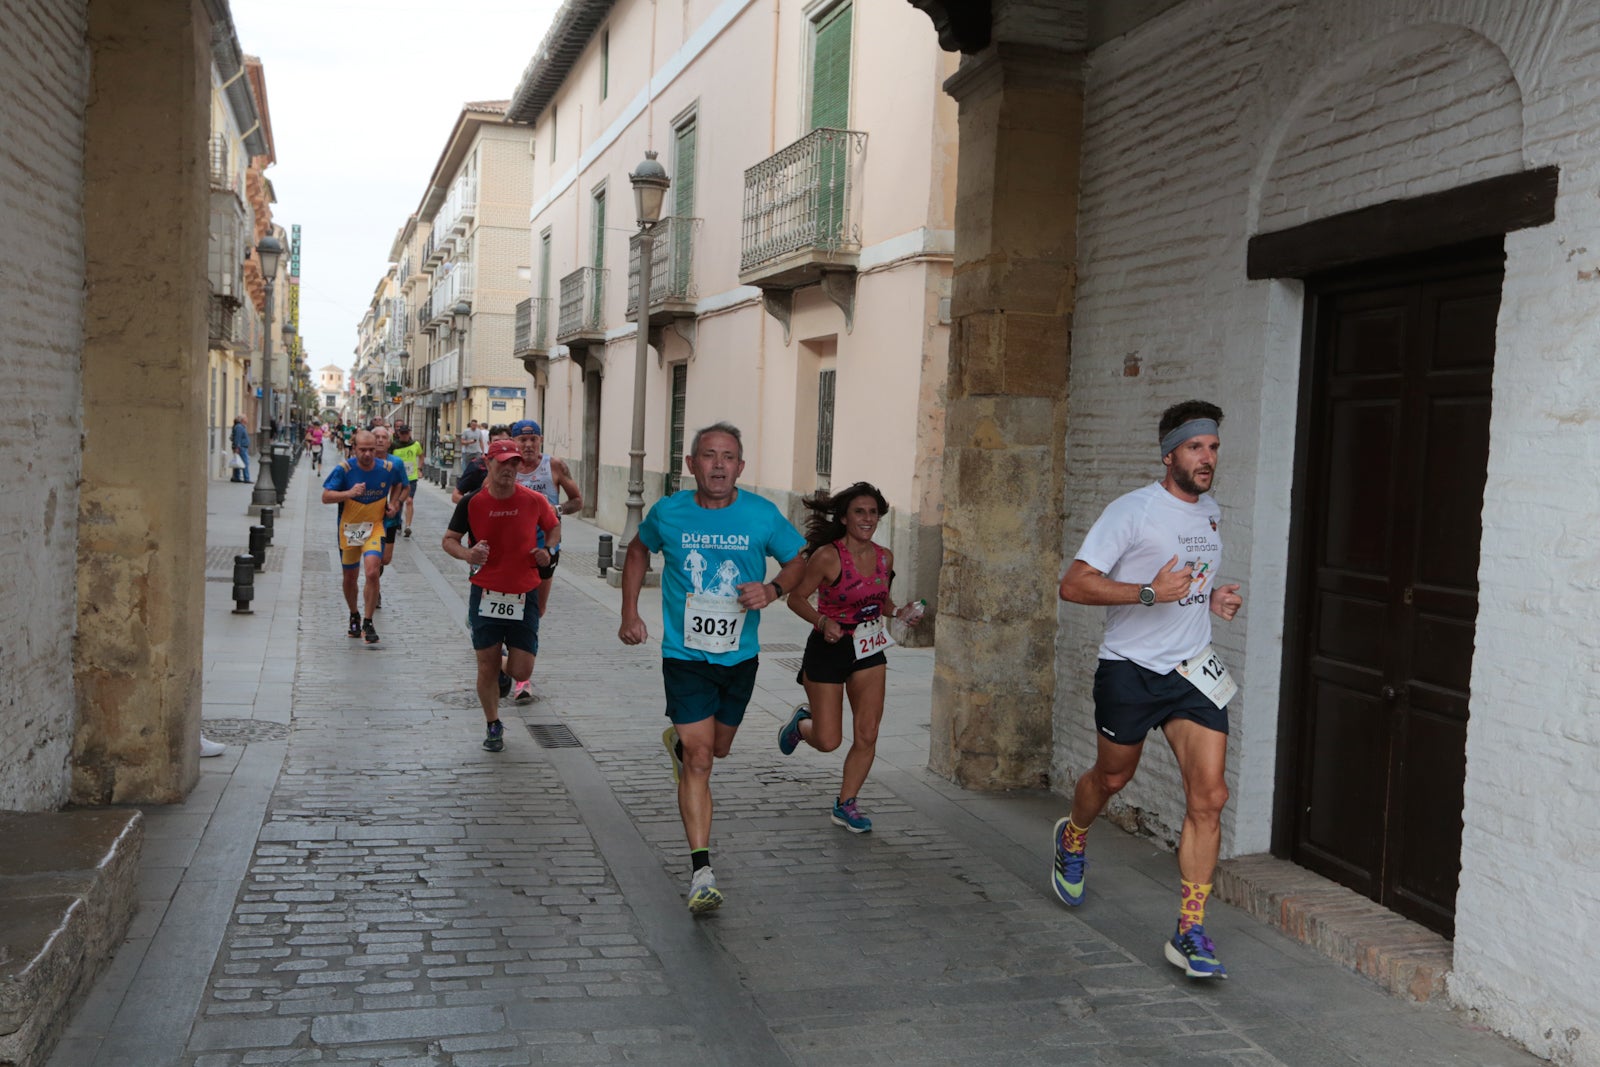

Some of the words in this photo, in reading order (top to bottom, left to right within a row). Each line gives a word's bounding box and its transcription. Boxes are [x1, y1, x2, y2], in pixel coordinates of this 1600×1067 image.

[1177, 535, 1207, 544] fuerzas
[1186, 544, 1218, 552] armadas
[490, 602, 515, 616] 786
[692, 616, 738, 636] 3031
